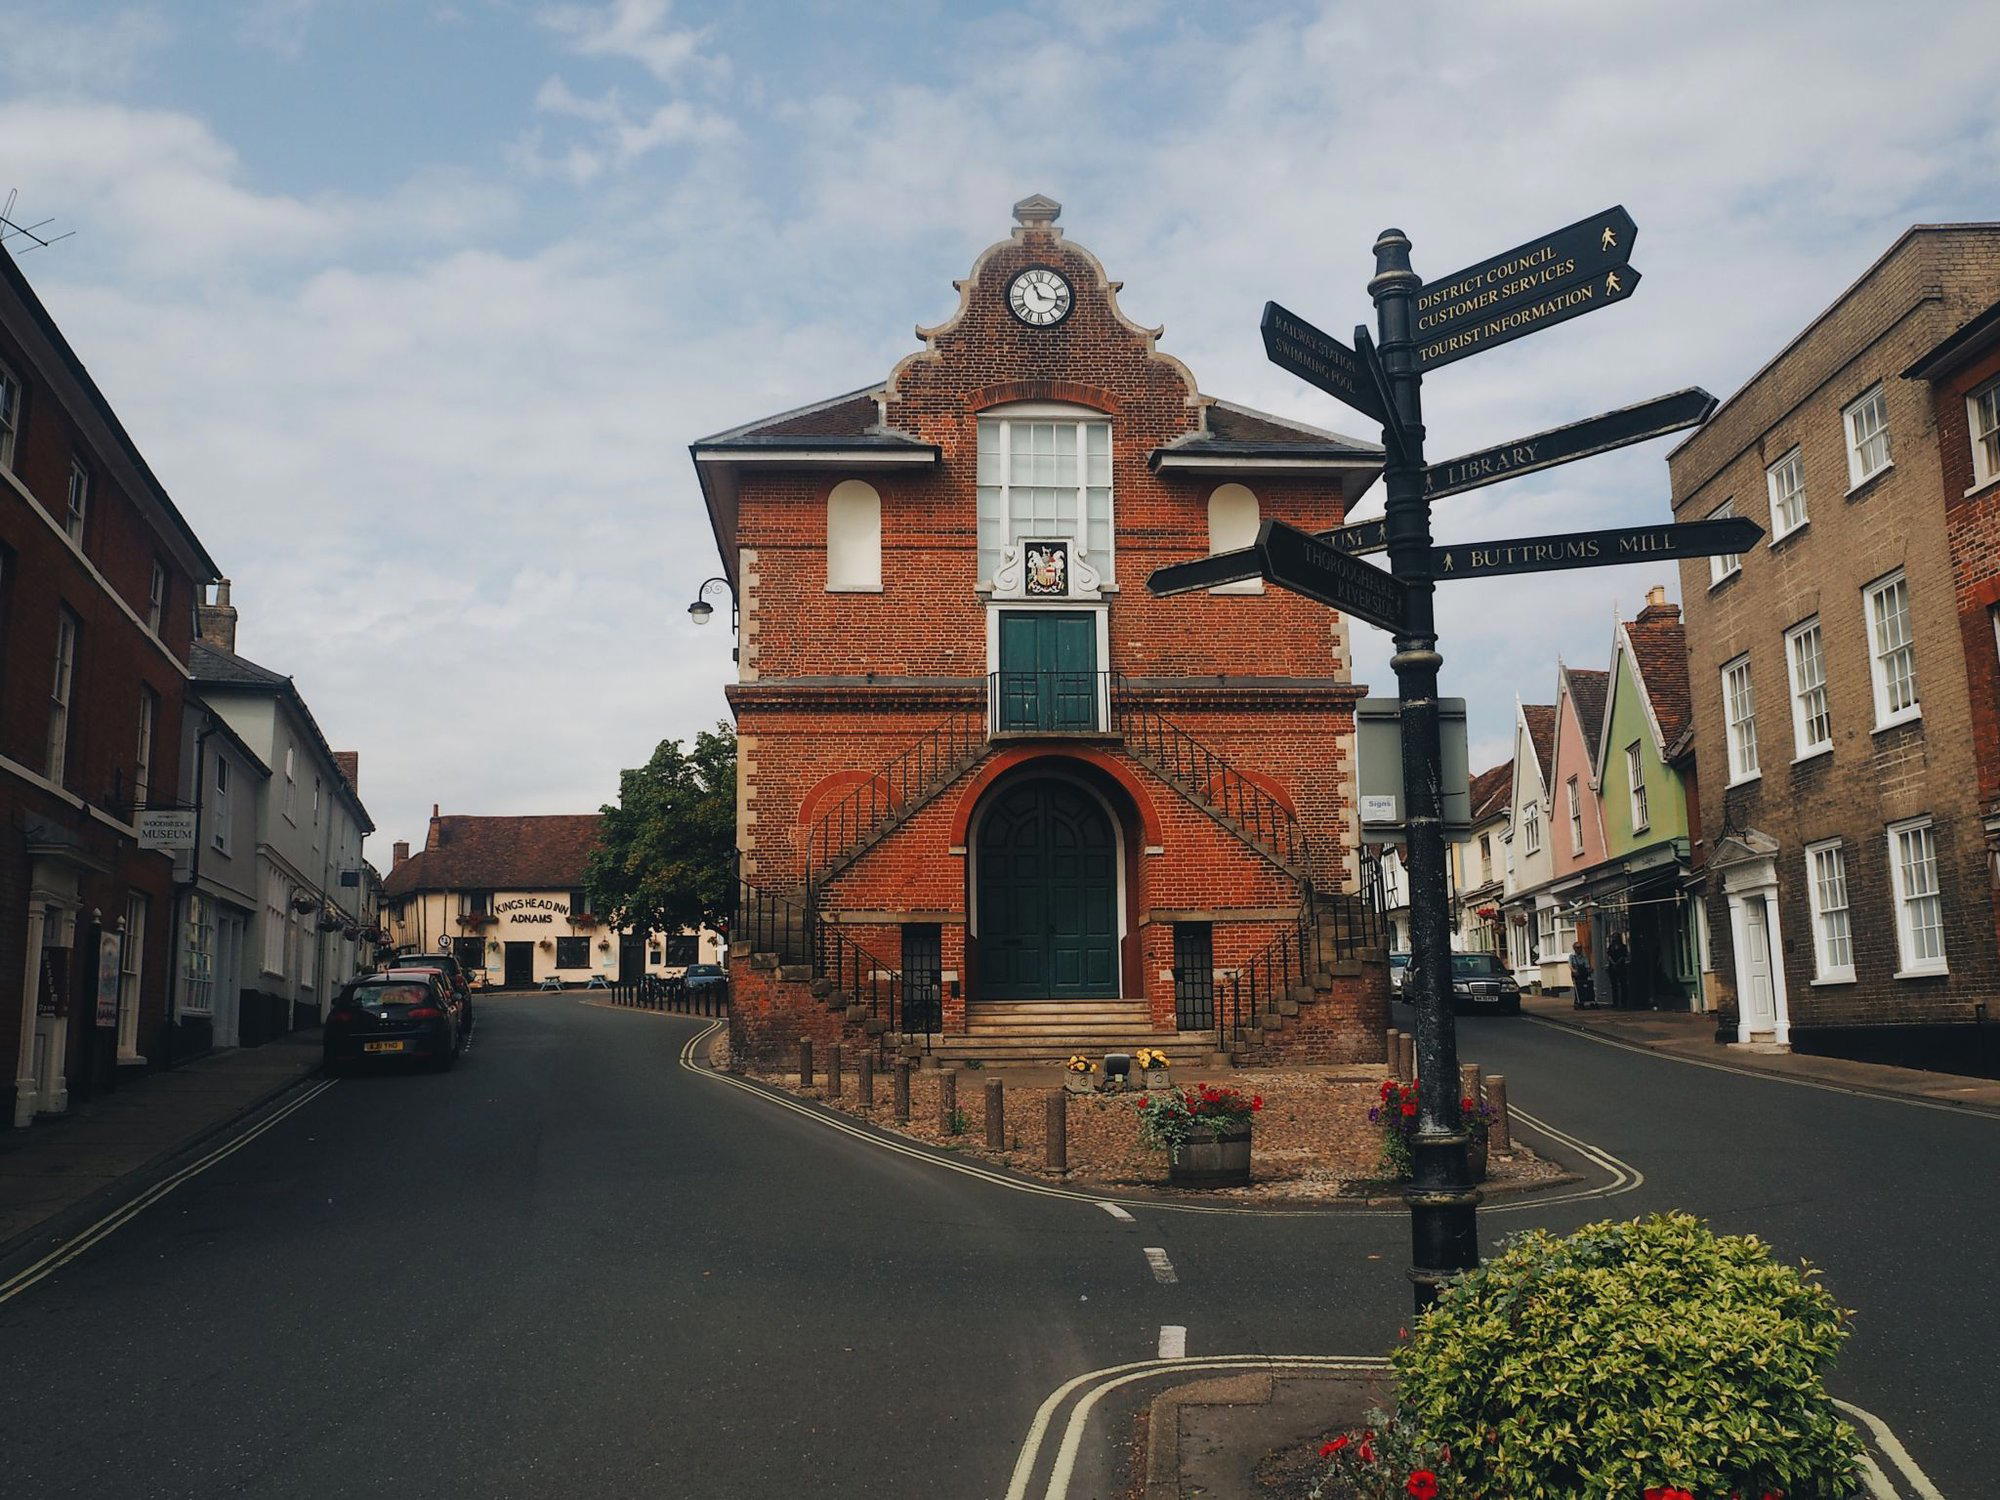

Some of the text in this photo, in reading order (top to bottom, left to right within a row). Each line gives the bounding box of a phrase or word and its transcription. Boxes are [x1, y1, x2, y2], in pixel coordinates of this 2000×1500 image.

[1418, 246, 1557, 311] DISTRICT COUNCIL
[1418, 259, 1575, 330] CUSTOMER SERVICES
[1275, 315, 1356, 372] RAILWAY STATION
[1419, 285, 1594, 362] TOURIST INFORMATION
[1275, 337, 1356, 394] SWIMMING POOL
[1447, 442, 1541, 485] LIBRARY
[1470, 533, 1677, 568] BUTTRUMS MILL
[142, 829, 192, 839] MUSEUM
[495, 898, 570, 915] KINGS HEAD INN
[510, 913, 553, 923] ADNAMS
